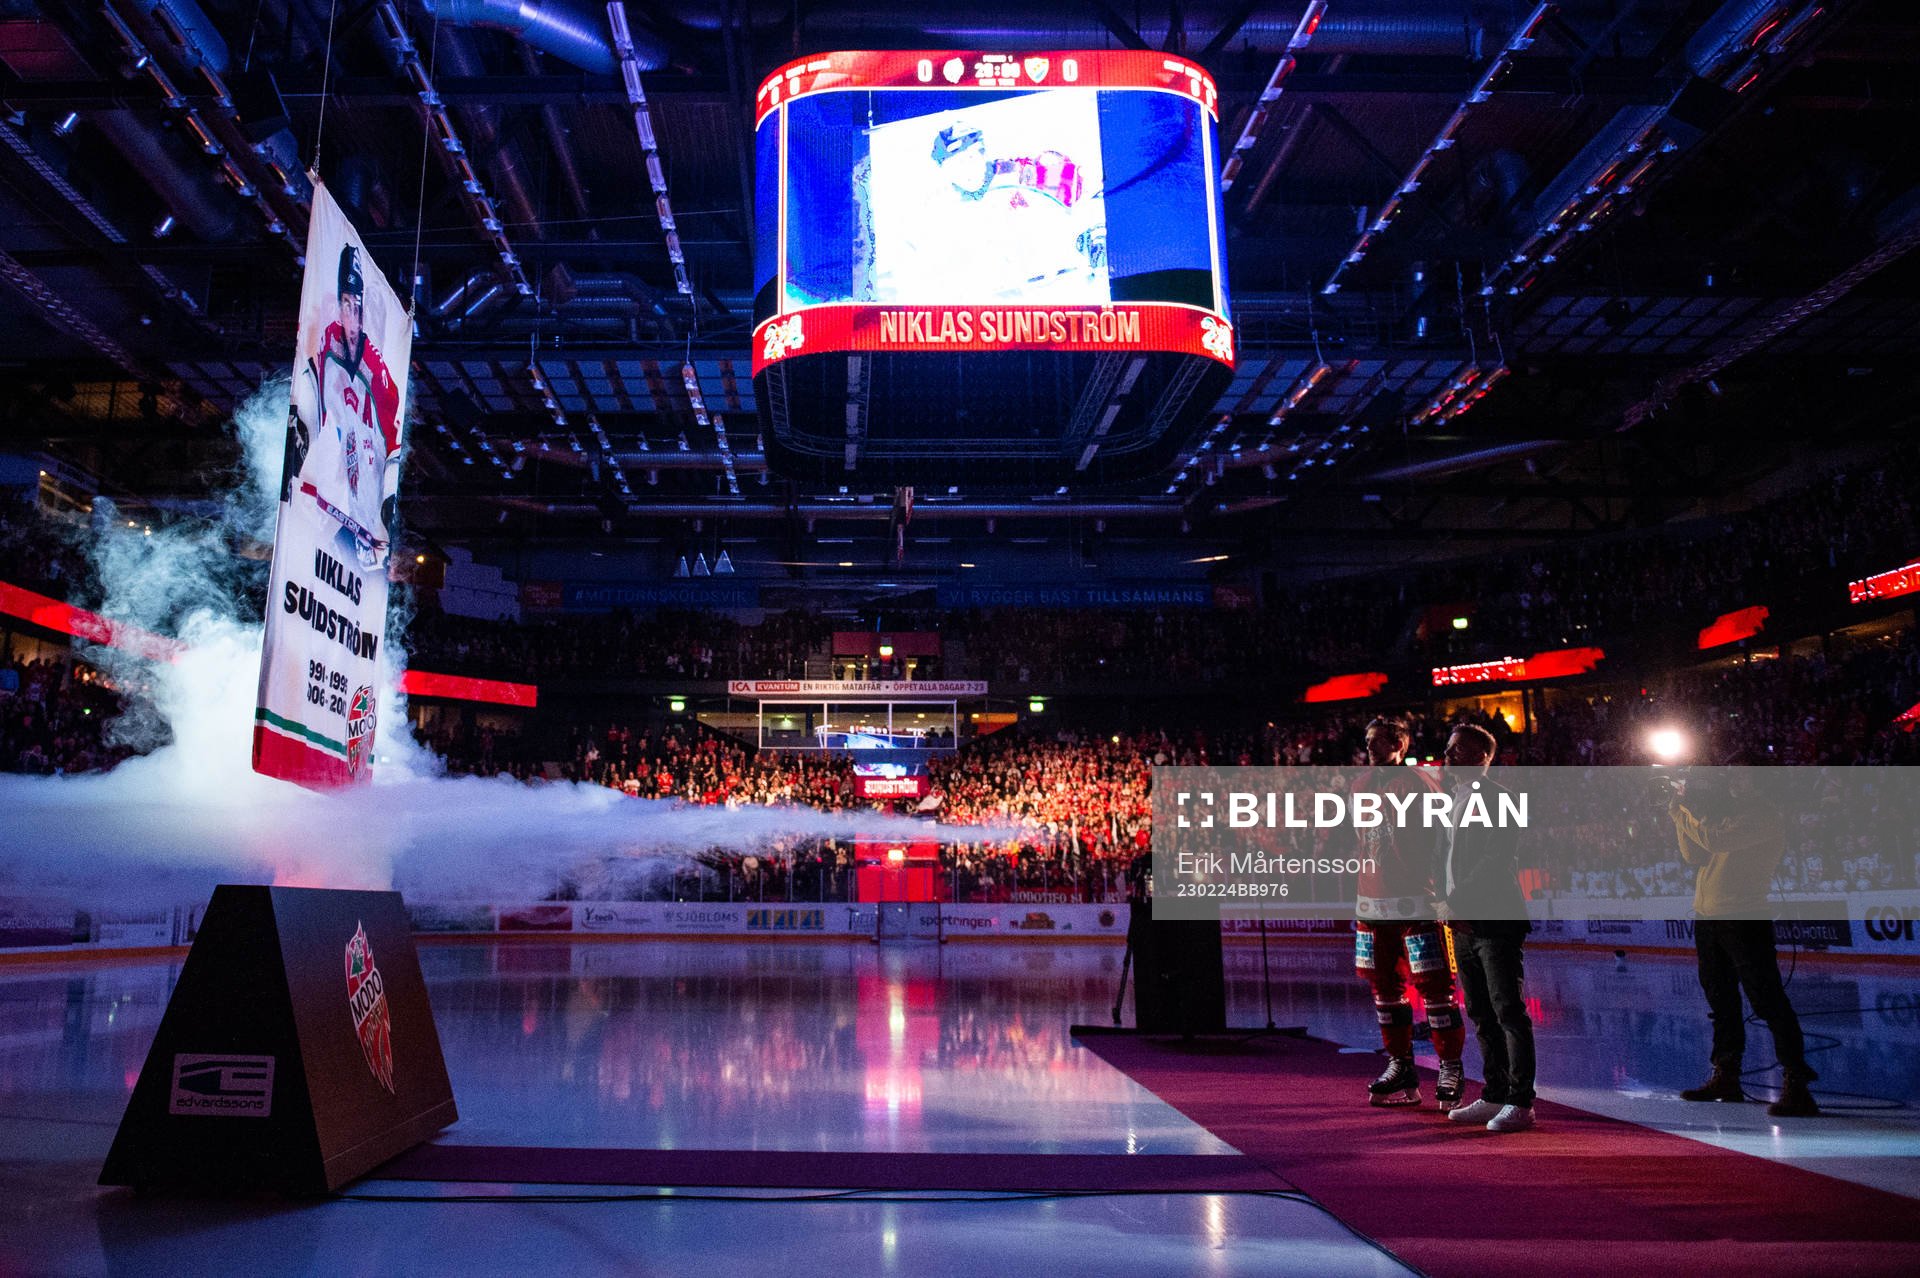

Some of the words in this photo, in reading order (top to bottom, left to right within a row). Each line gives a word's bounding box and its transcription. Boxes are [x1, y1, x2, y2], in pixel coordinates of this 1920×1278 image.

[917, 59, 932, 82] 0
[1062, 59, 1077, 82] 0
[880, 311, 973, 343] NIKLAS
[980, 306, 1140, 343] SUNDSTRÖM
[326, 504, 361, 534] EASTON
[1086, 590, 1214, 603] TILLSAMMANS
[1848, 579, 1866, 604] 24
[732, 682, 751, 692] ICA
[756, 683, 799, 691] KVANTUM
[803, 682, 813, 691] EN
[815, 682, 840, 691] RIKTIG
[919, 682, 937, 691] ALLA
[939, 682, 965, 692] DAGAR
[1432, 667, 1450, 686] 24
[864, 778, 918, 795] SUNDSTRÖM
[1802, 925, 1839, 940] HOTELL
[351, 970, 382, 1026] MODO
